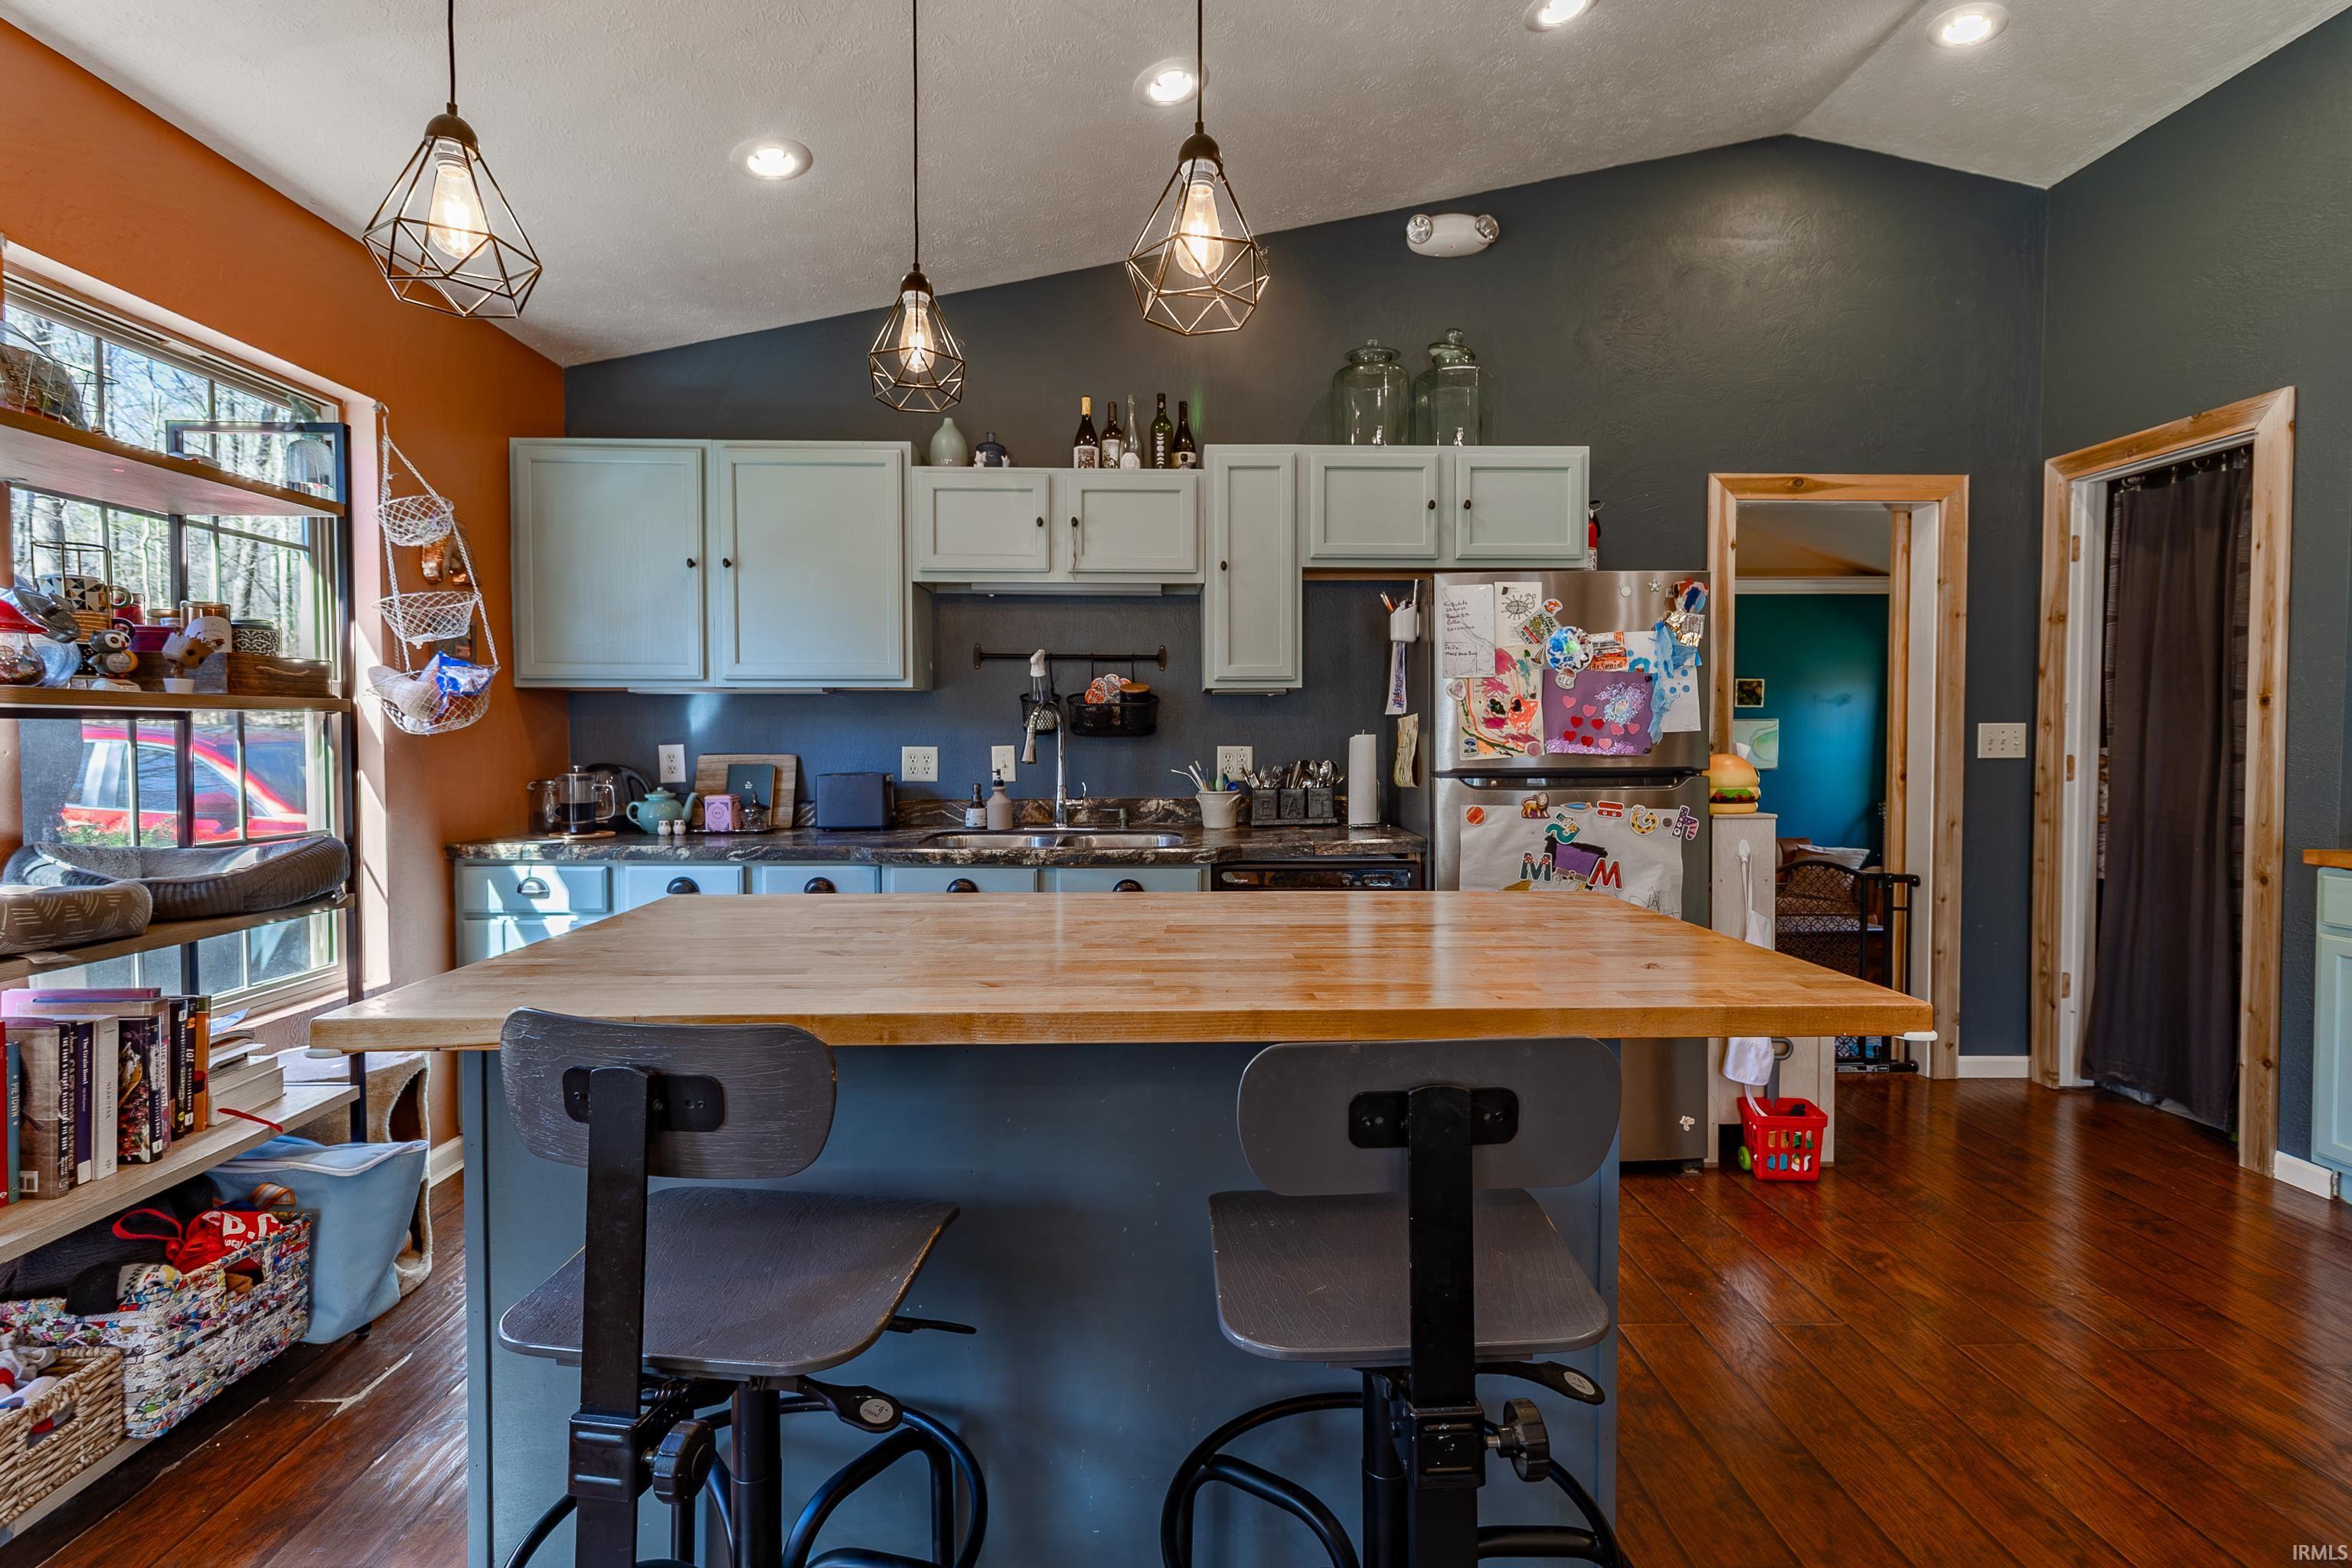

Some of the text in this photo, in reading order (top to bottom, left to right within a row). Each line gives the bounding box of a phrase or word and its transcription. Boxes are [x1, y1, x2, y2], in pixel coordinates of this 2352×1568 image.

[1537, 613, 1554, 636] ANOTHE
[1520, 851, 1552, 881] M
[186, 1048, 194, 1063] 101
[11, 1082, 20, 1118] PIE TOWN
